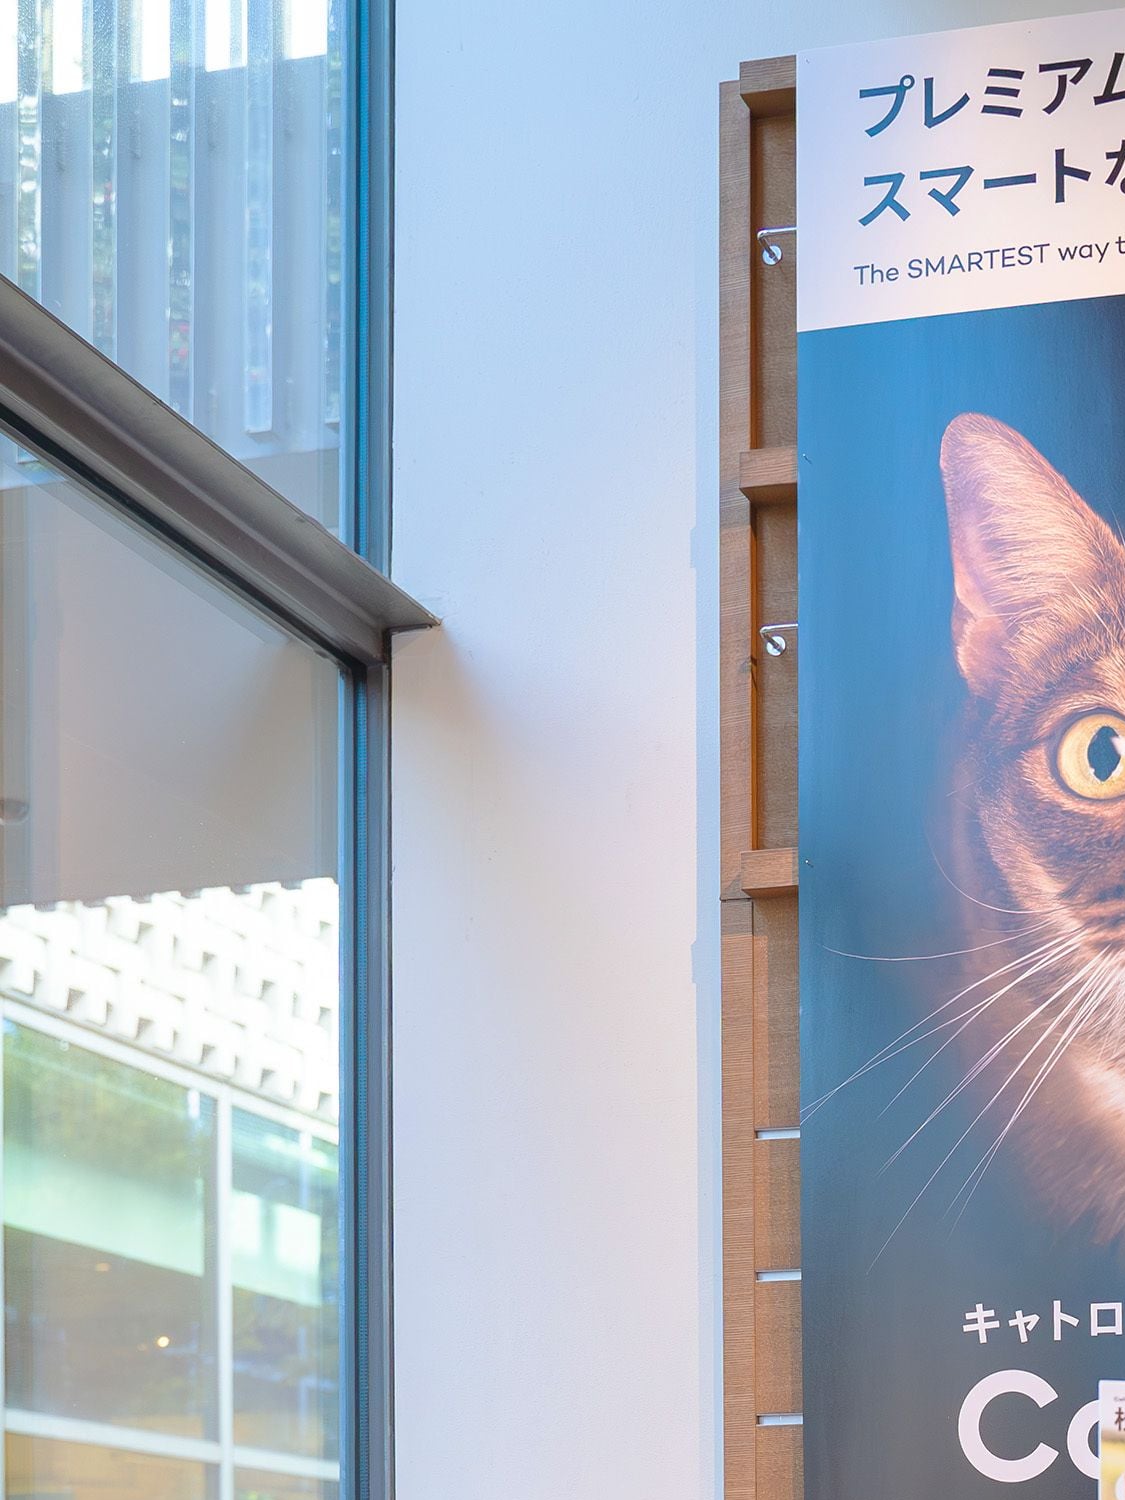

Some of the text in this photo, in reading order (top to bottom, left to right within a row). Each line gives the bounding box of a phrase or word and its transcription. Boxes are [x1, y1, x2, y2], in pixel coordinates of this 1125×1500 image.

[853, 262, 900, 288] The
[906, 242, 1051, 281] SMARTEST
[1057, 237, 1110, 269] way
